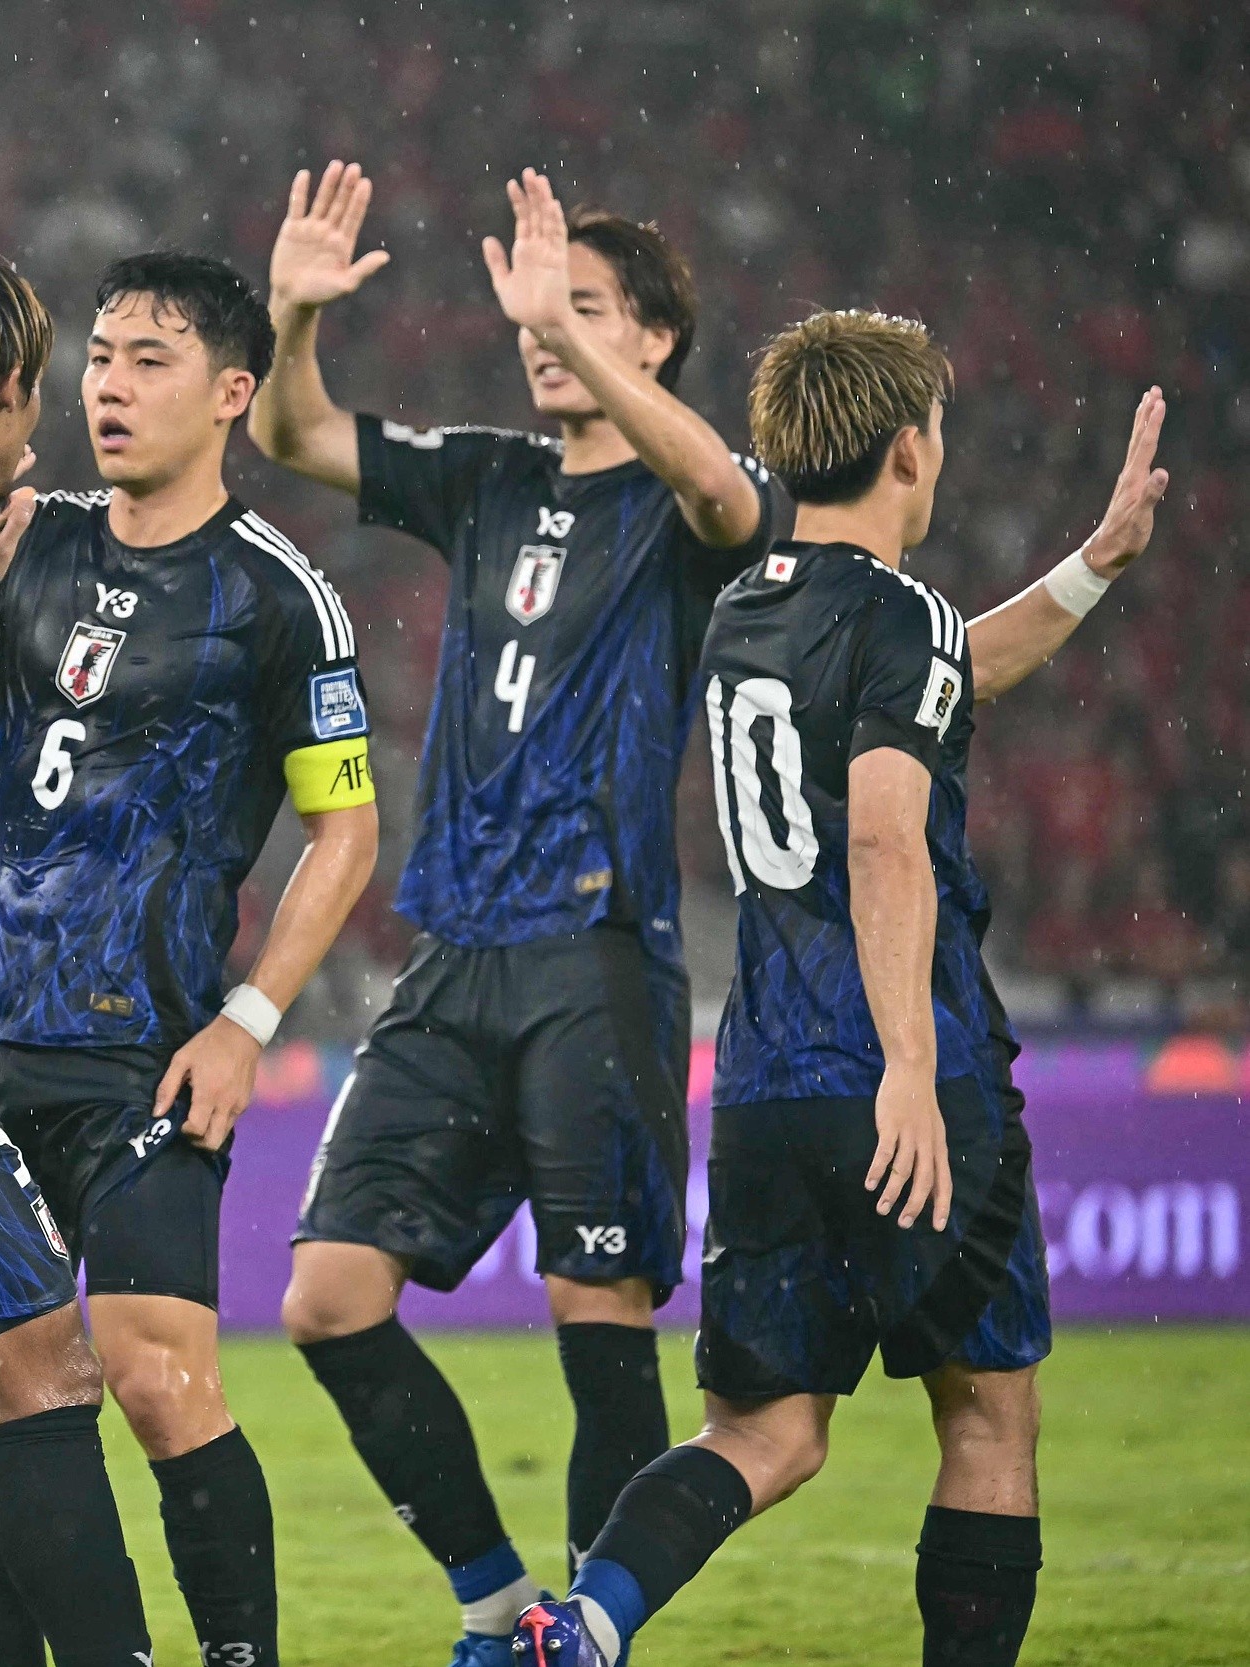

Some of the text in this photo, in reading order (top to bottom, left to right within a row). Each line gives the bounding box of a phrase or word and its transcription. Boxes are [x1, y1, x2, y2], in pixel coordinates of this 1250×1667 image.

[95, 582, 138, 618] Y-3
[494, 639, 537, 733] 4
[31, 718, 87, 811] 6
[330, 753, 369, 795] AF
[705, 673, 820, 898] 10
[576, 1225, 628, 1255] Y-3
